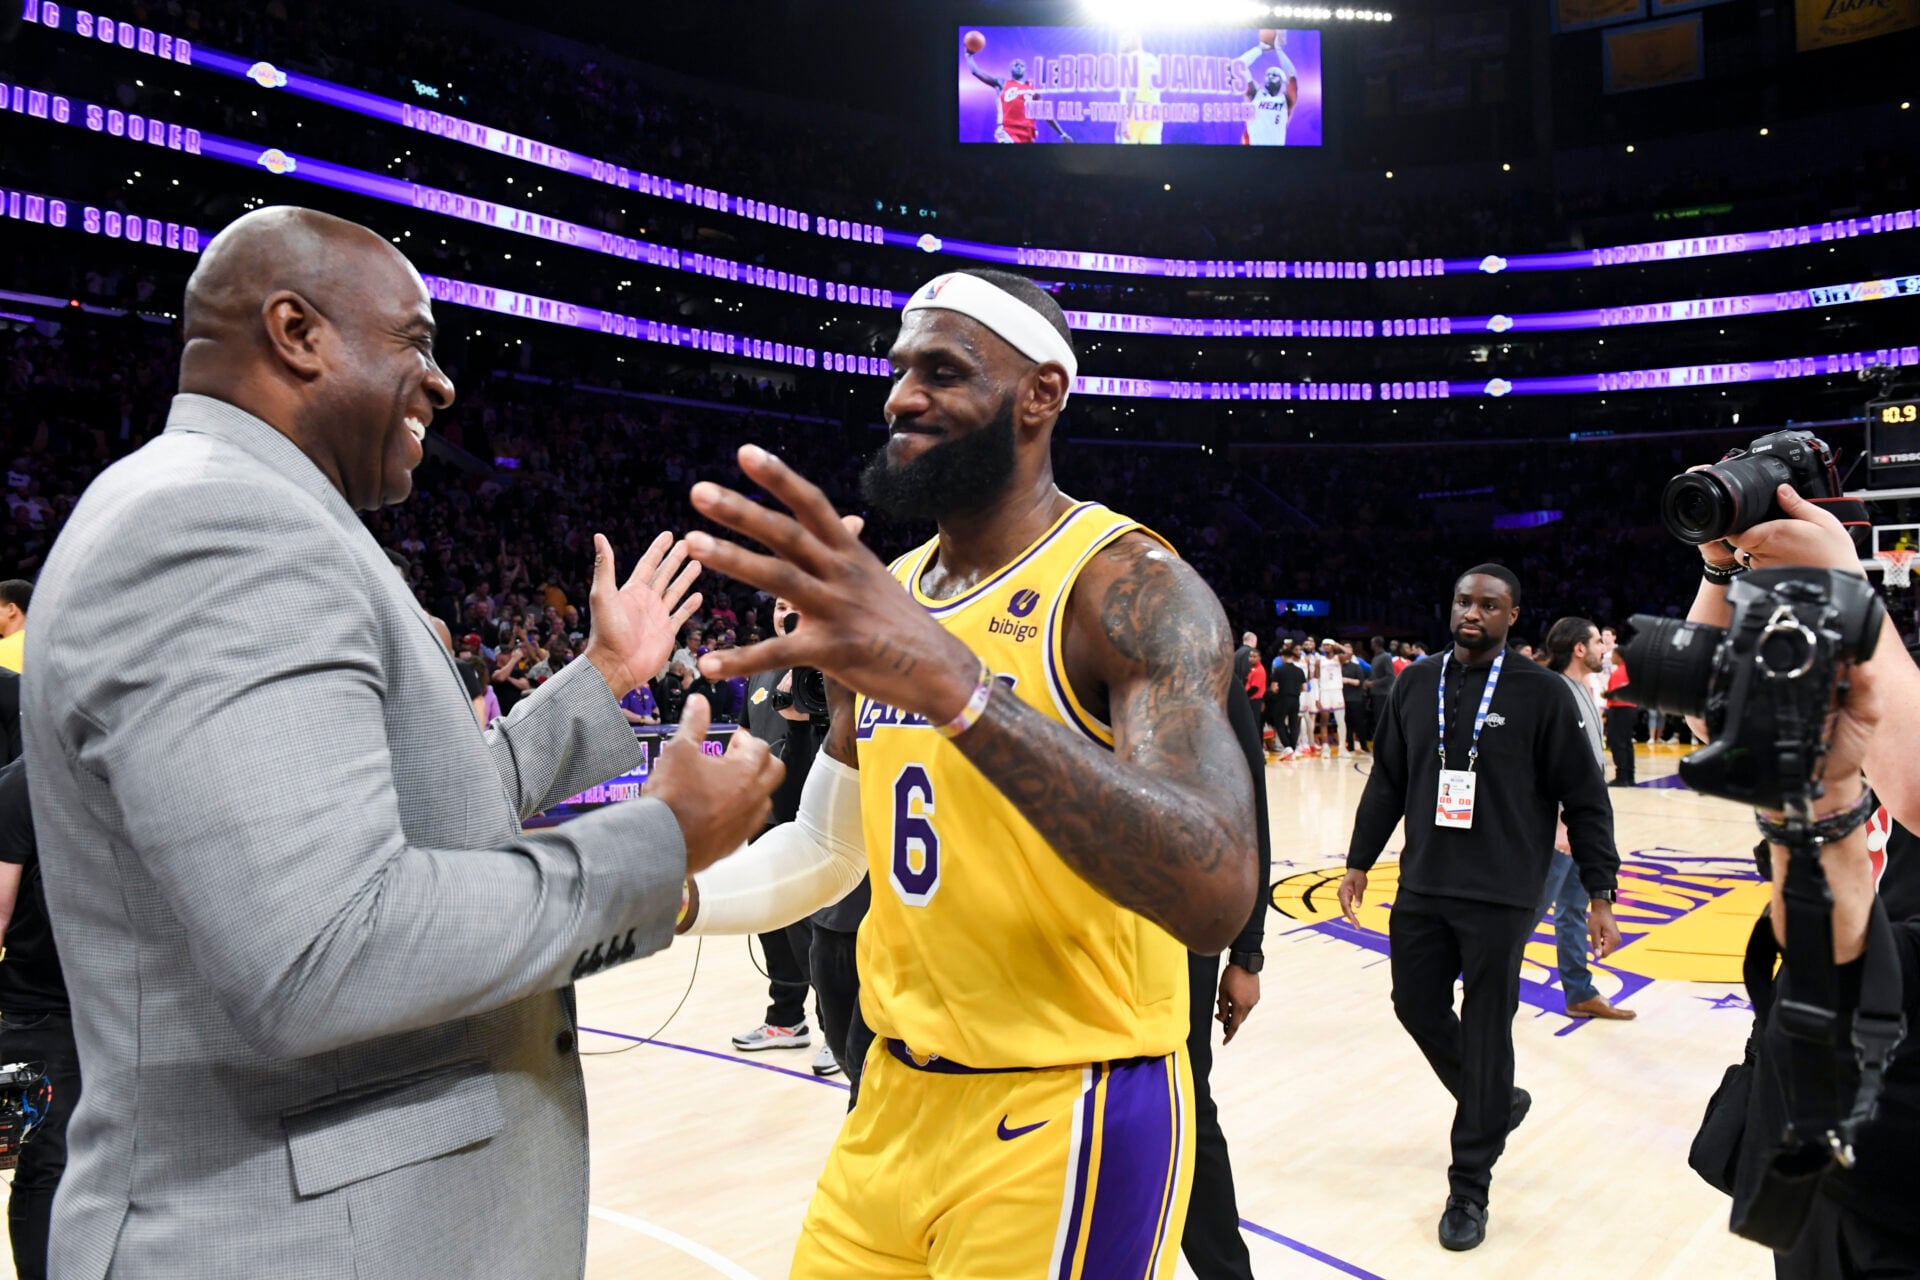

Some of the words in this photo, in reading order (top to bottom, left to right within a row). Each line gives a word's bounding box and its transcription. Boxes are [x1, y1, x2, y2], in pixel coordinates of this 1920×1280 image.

[76, 10, 192, 65] SCORER
[1149, 54, 1248, 95] JAMES
[1057, 101, 1129, 122] ALL-TIME
[1133, 102, 1200, 123] LEADING
[1202, 103, 1257, 123] SCORER
[1258, 101, 1285, 112] HEAT
[86, 104, 202, 155] SCORER
[501, 134, 570, 171] JAMES
[638, 172, 729, 213] ALL-TIME
[736, 197, 809, 232] LEADING
[816, 216, 884, 245] SCORER
[83, 206, 199, 253] SCORER
[1678, 233, 1744, 257] JAMES
[510, 211, 578, 243] JAMES
[647, 243, 738, 281] ALL-TIME
[746, 264, 818, 297] LEADING
[825, 282, 893, 308] SCORER
[1091, 254, 1147, 275] JAMES
[1294, 261, 1367, 279] LEADING
[1684, 297, 1751, 319] JAMES
[510, 295, 578, 326] JAMES
[647, 320, 735, 355] ALL-TIME
[743, 337, 816, 368] LEADING
[823, 351, 890, 377] SCORER
[1099, 315, 1153, 333] JAMES
[1301, 320, 1374, 338] LEADING
[1683, 363, 1751, 385] JAMES
[1096, 379, 1151, 396] JAMES
[1299, 383, 1372, 400] LEADING
[988, 616, 1038, 643] bibigo
[889, 762, 942, 908] 6
